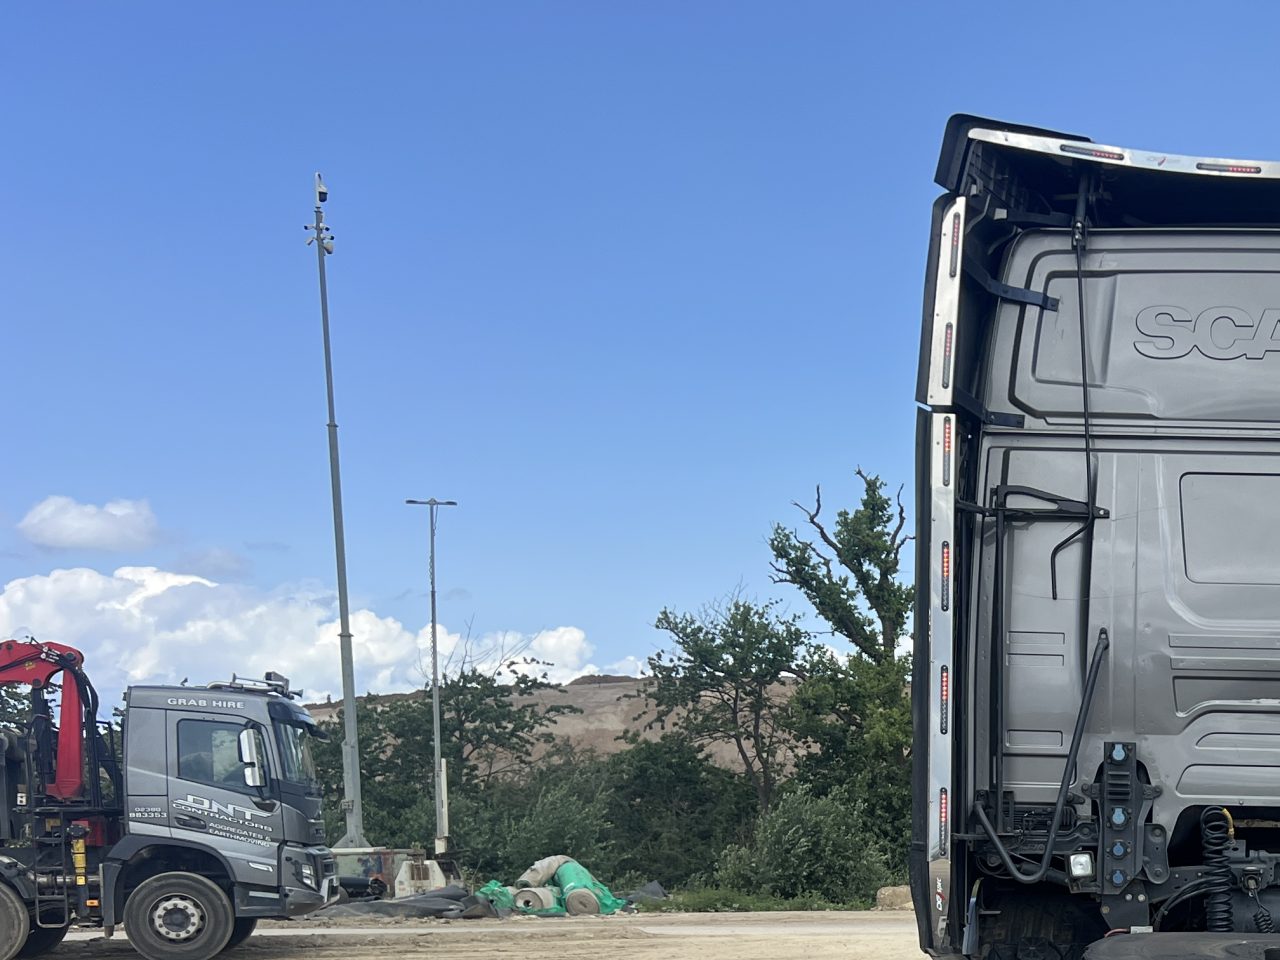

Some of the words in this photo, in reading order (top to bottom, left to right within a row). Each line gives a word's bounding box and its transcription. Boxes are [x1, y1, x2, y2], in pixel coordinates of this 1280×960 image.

[167, 698, 207, 707] GRAB
[212, 700, 245, 709] HIRE
[173, 804, 273, 832] CONTRACTORS
[209, 822, 263, 840] AGGREGATES
[209, 829, 270, 848] EARTHMOVING
